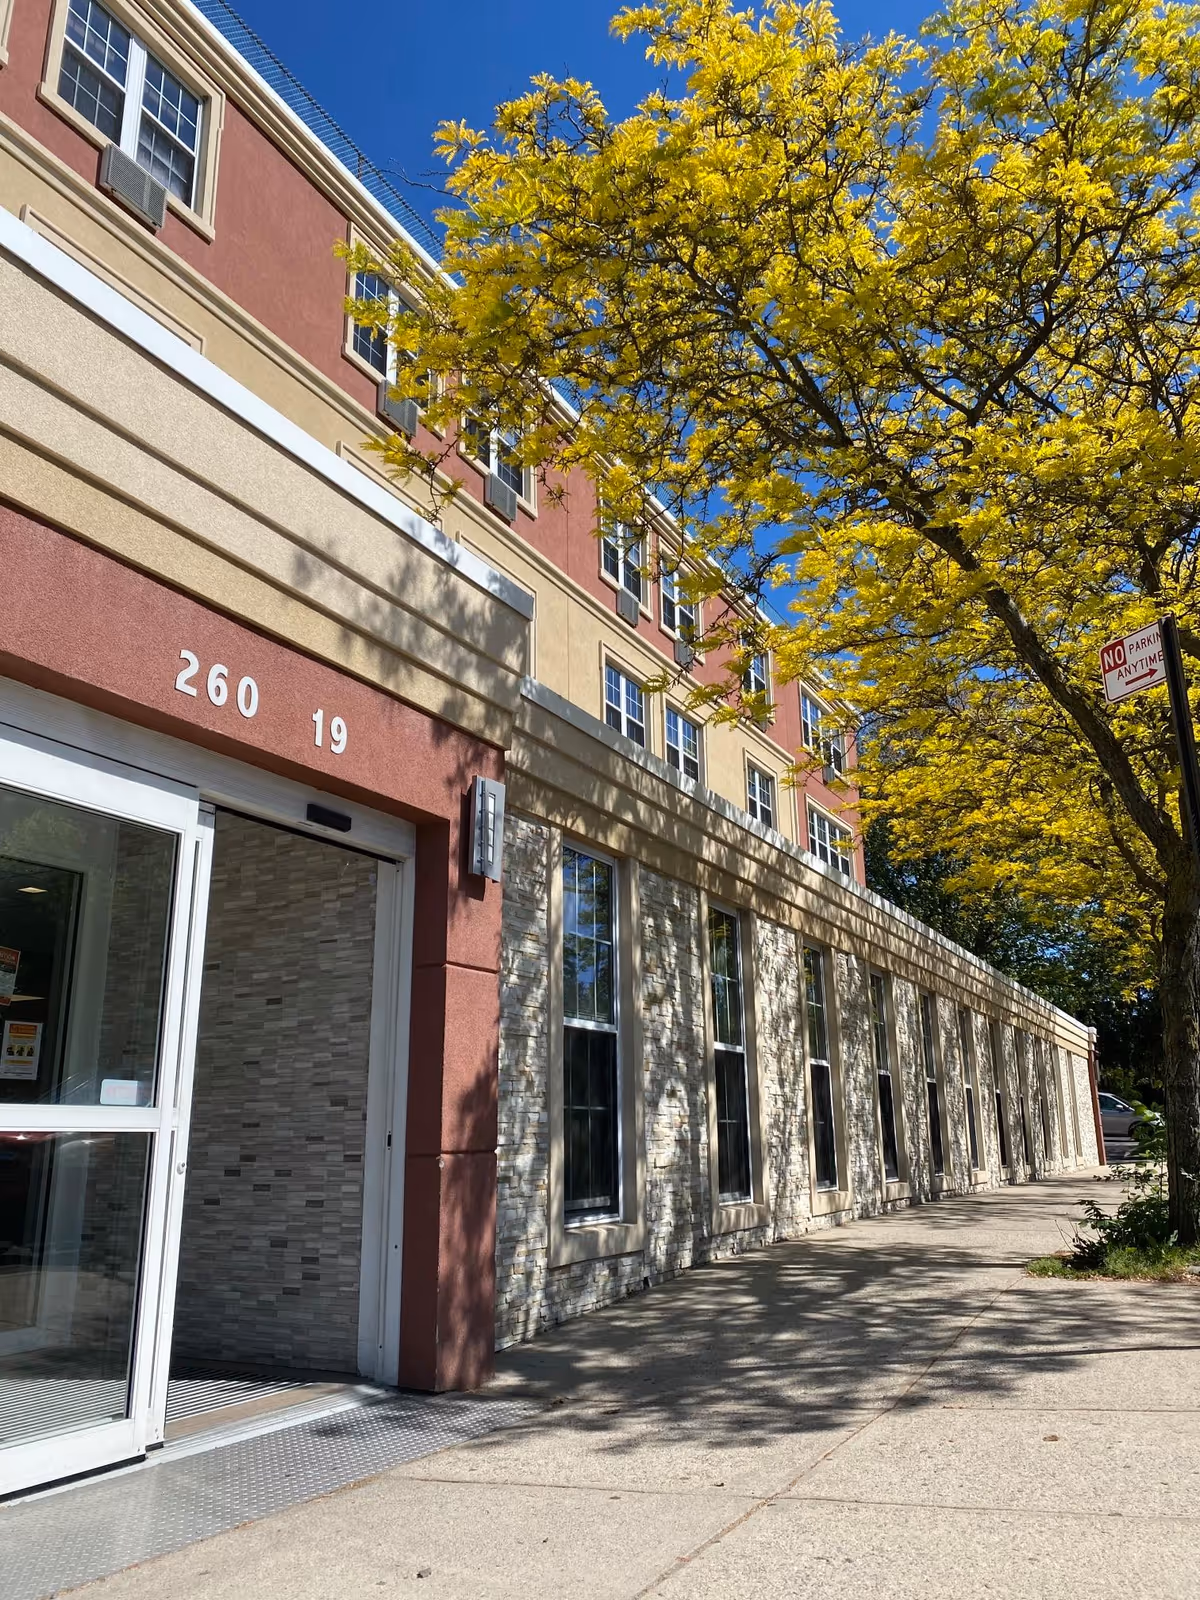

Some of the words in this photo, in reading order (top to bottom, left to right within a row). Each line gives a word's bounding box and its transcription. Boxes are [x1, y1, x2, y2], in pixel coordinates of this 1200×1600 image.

[1103, 645, 1124, 670] NO
[1128, 631, 1162, 655] PARKIN
[1117, 650, 1164, 681] ANYTIME
[174, 648, 259, 718] 260
[311, 708, 348, 754] 19
